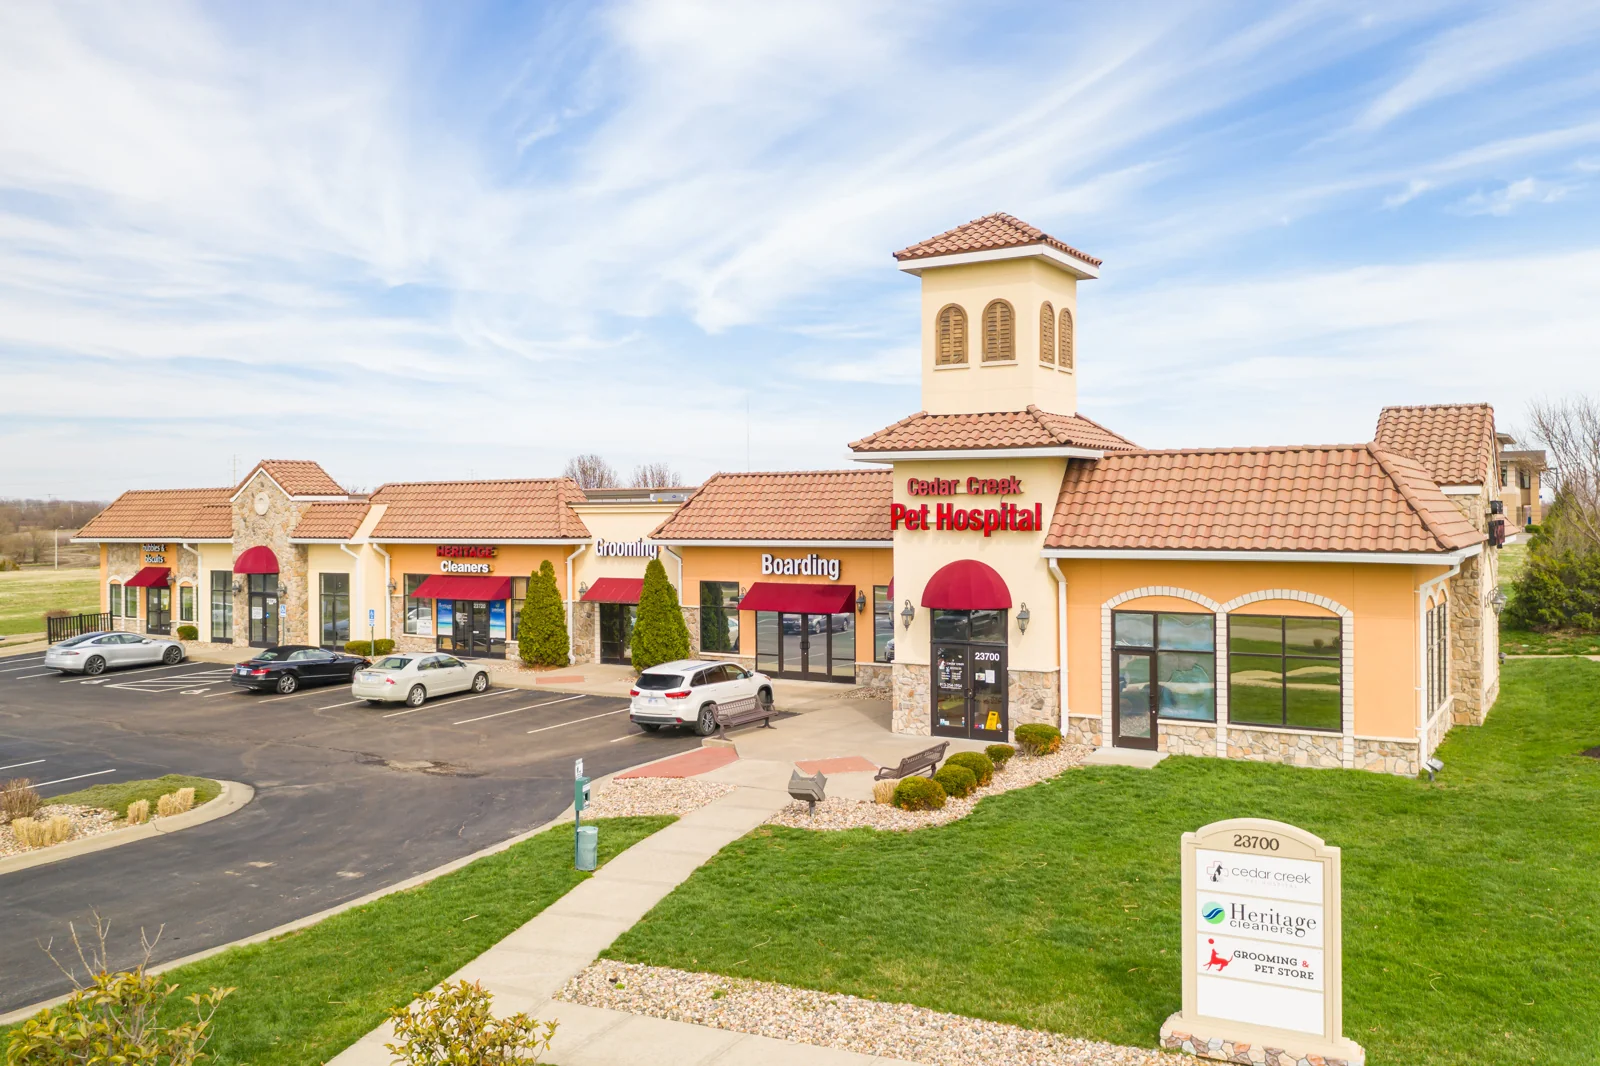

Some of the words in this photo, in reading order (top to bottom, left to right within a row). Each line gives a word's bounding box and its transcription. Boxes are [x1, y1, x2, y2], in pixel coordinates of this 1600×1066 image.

[907, 477, 959, 496] Cedar
[966, 475, 1022, 495] Creek
[890, 502, 930, 531] Pet
[936, 502, 1042, 537] Hospital
[436, 546, 493, 558] HERITAGE
[595, 537, 659, 560] Grooming
[440, 560, 489, 573] Cleaners
[761, 553, 840, 581] Boarding
[974, 652, 1000, 661] 23700
[1233, 834, 1280, 851] 23700
[1231, 867, 1271, 880] cedar
[1273, 872, 1311, 885] creek
[1229, 902, 1317, 938] Heritage
[1229, 920, 1294, 935] cleaners
[1233, 950, 1298, 966] GROOMING
[1302, 960, 1310, 968] &
[1254, 964, 1275, 974] PET
[1277, 967, 1315, 980] STORE
